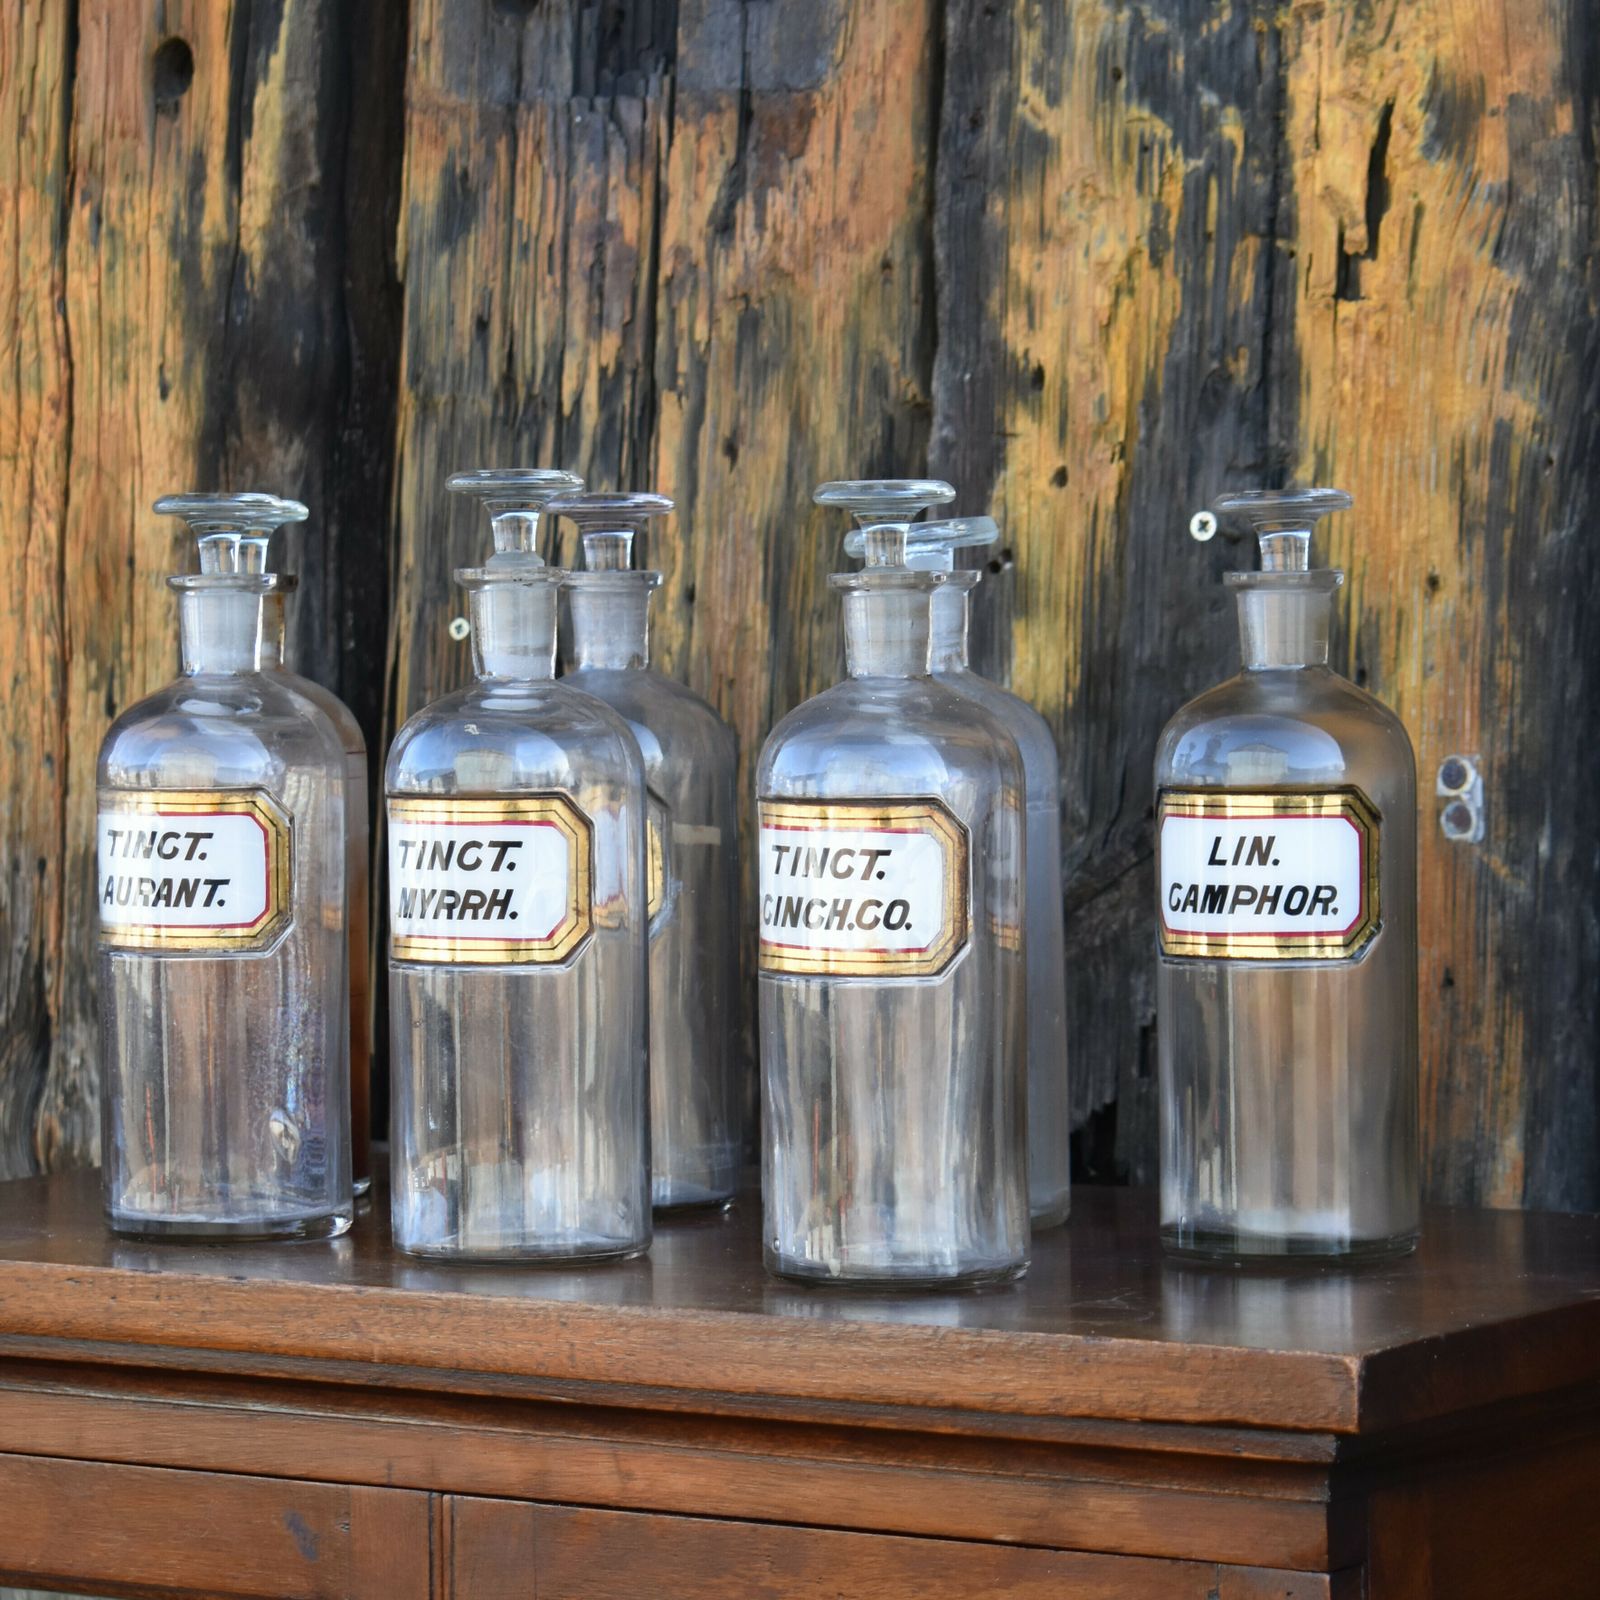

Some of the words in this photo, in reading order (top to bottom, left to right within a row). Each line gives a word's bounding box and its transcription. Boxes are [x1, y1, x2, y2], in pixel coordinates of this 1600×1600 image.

[107, 829, 214, 861] TINCT.
[398, 840, 523, 872] TINCT.
[1207, 835, 1280, 866] LIN.
[772, 844, 892, 881] TINCT.
[103, 874, 231, 908] AURANT.
[398, 887, 519, 920] MYRRH.
[1168, 882, 1339, 916] CAMPHOR.
